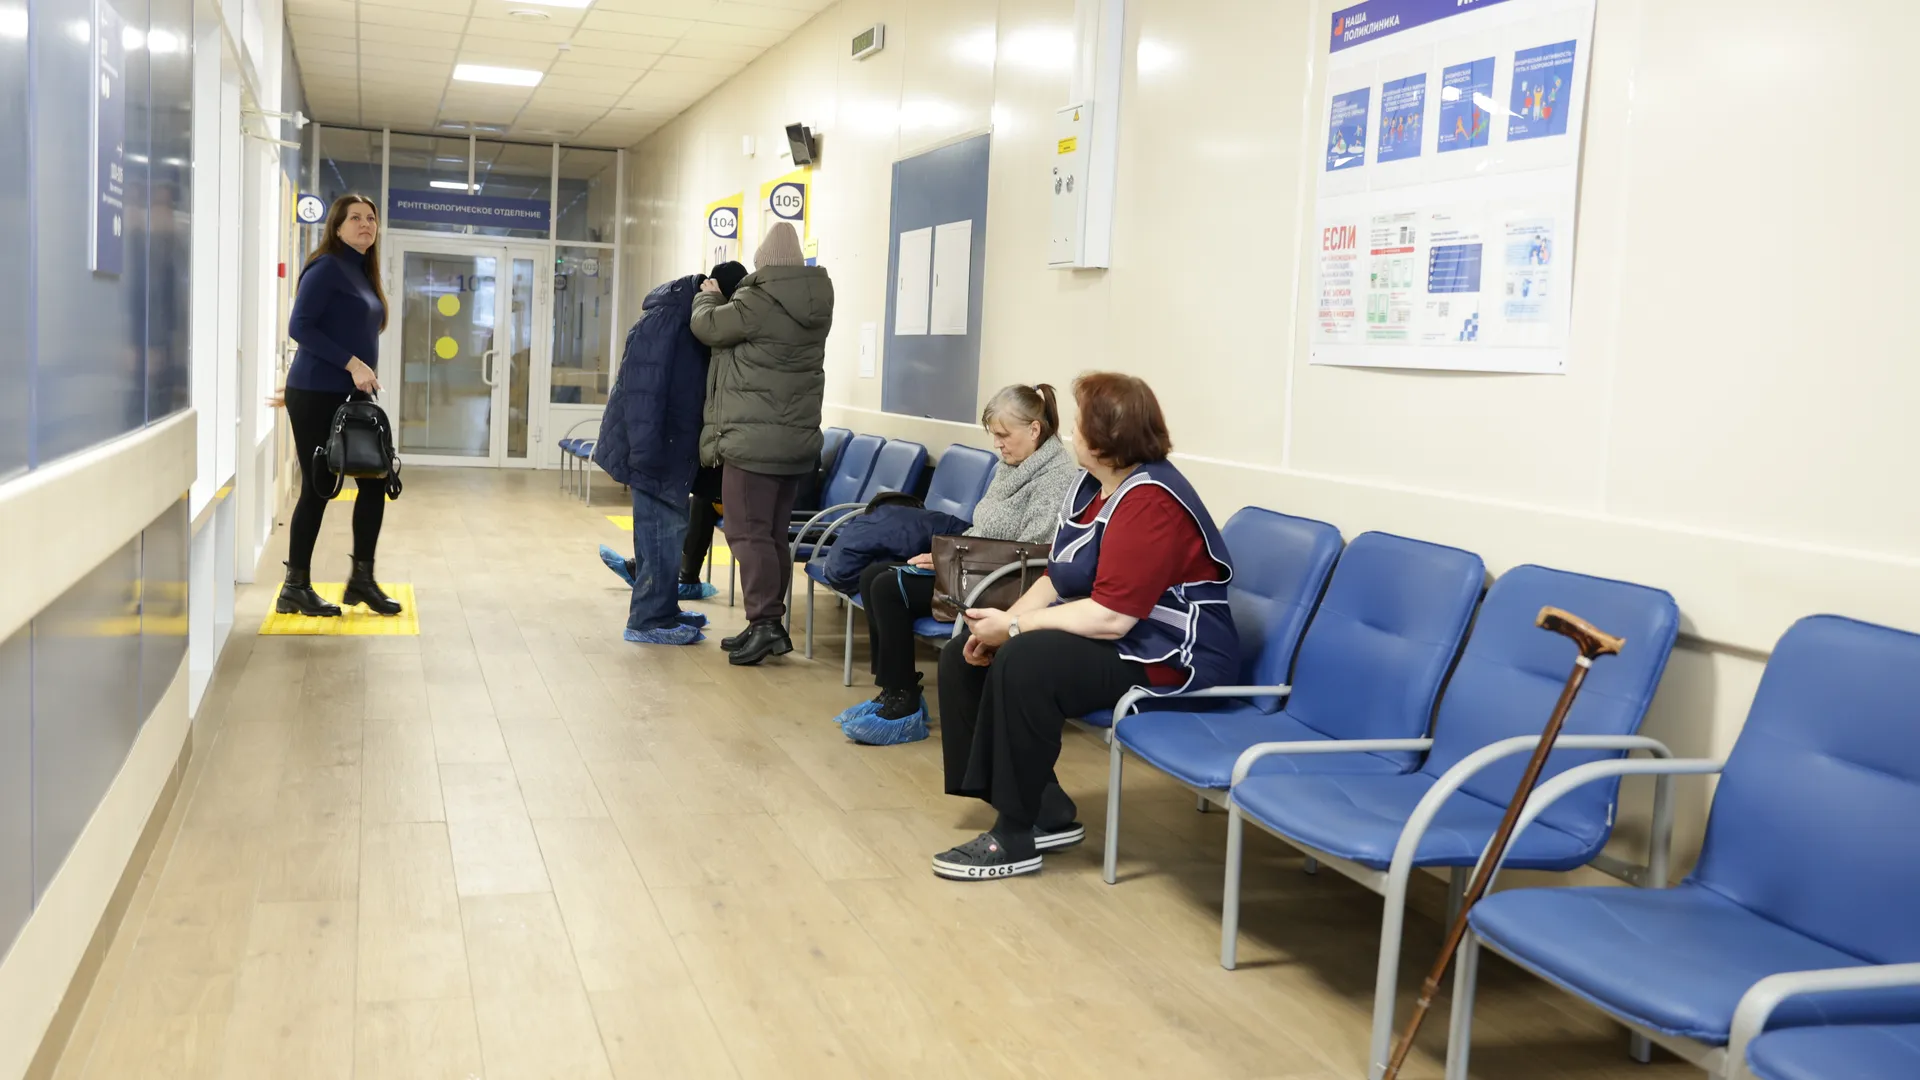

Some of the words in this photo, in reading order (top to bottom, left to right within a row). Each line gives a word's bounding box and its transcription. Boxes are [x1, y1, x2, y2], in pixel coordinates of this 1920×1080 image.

[1343, 14, 1400, 42] ПОЛИКЛИНИКА
[1345, 12, 1367, 28] НАША
[775, 195, 800, 208] 105
[397, 201, 492, 215] РЕНТГЕНОЛОГИЧЕСКОЕ
[494, 208, 541, 219] ОТДЕЛЕНИЕ
[713, 217, 734, 228] 104
[1323, 225, 1356, 251] ЕСЛИ
[968, 865, 1014, 876] crocs
